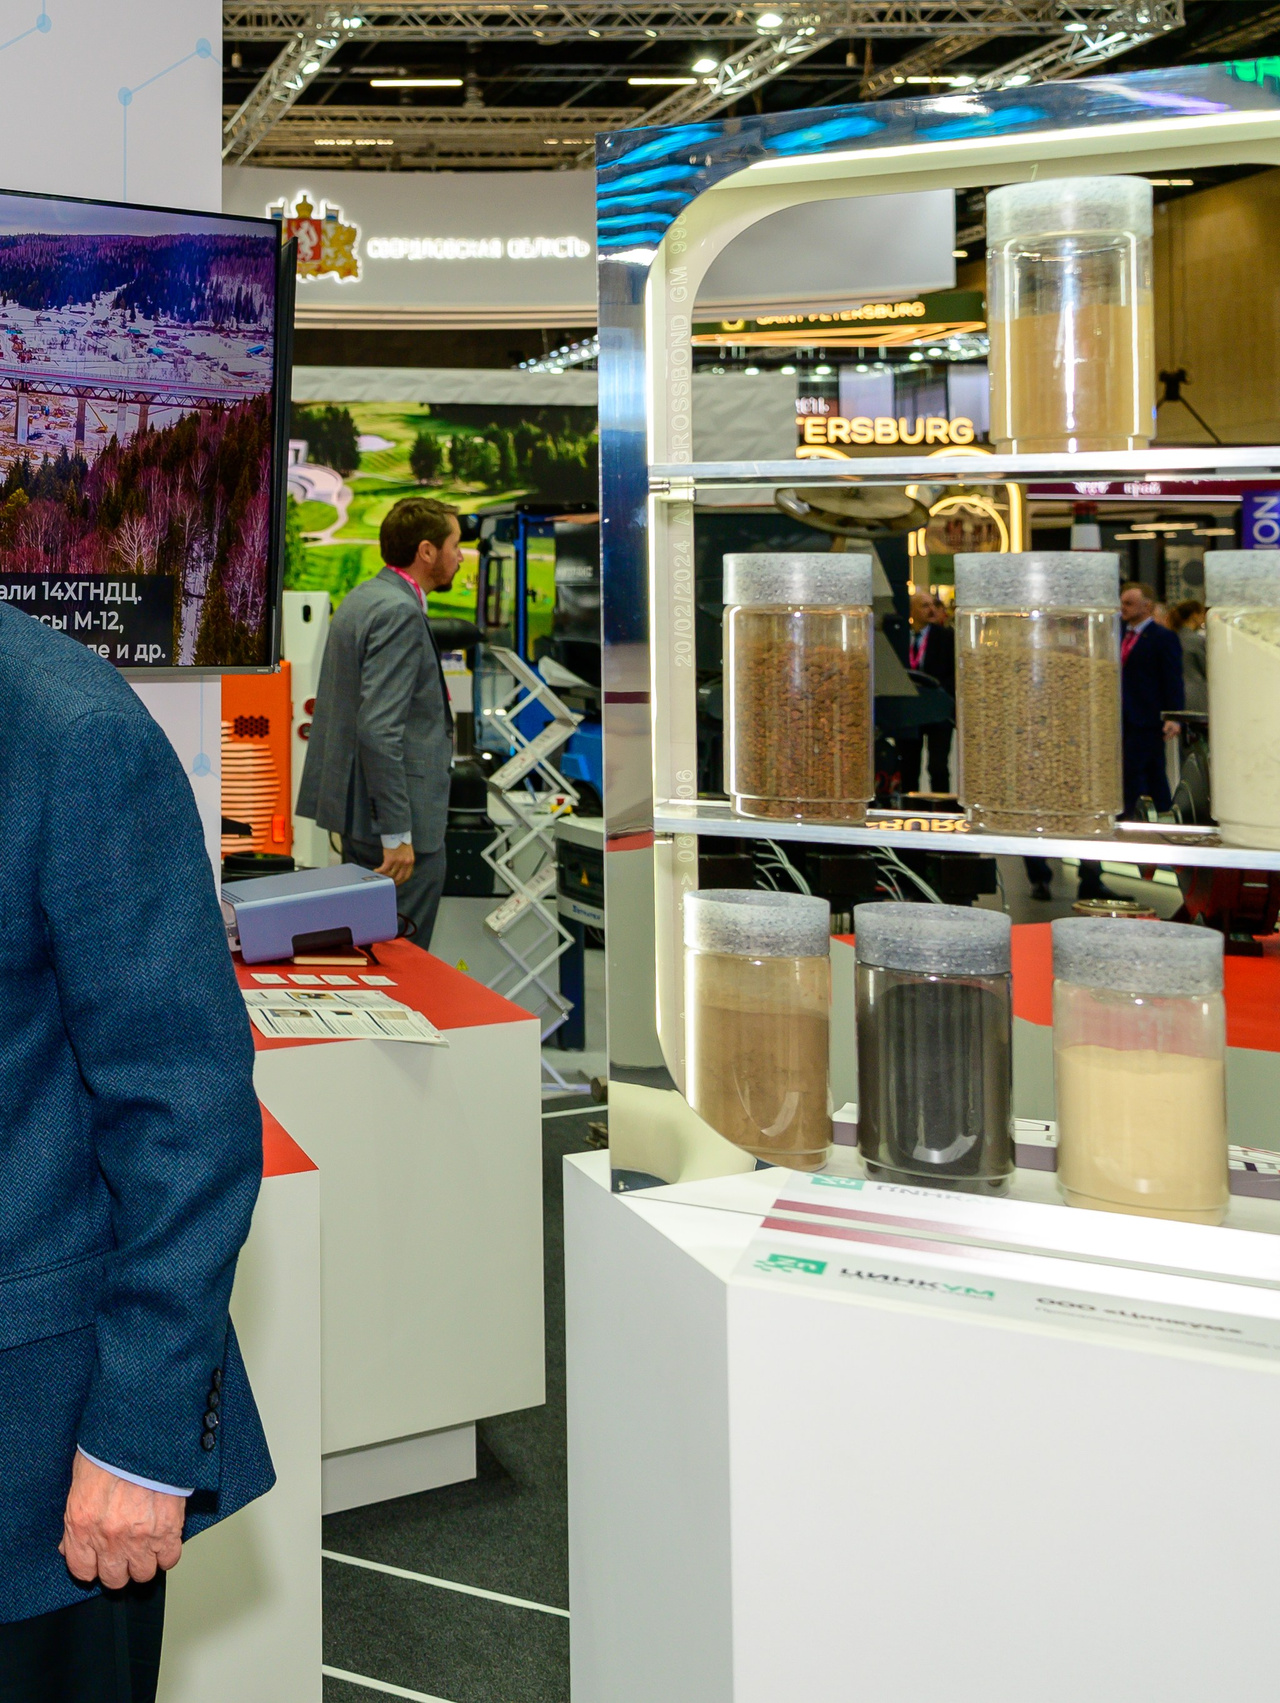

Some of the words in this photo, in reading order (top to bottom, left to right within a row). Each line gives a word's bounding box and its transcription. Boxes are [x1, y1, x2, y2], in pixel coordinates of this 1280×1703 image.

[670, 265, 688, 303] GM
[671, 314, 690, 464] GROSSBOND
[42, 581, 142, 604] 14ХГНДЦ.
[673, 541, 692, 668] 20/02/2024
[75, 611, 124, 634] М-12,
[117, 644, 129, 659] и
[134, 644, 166, 664] др.
[840, 1266, 996, 1298] ЦИНКУМ
